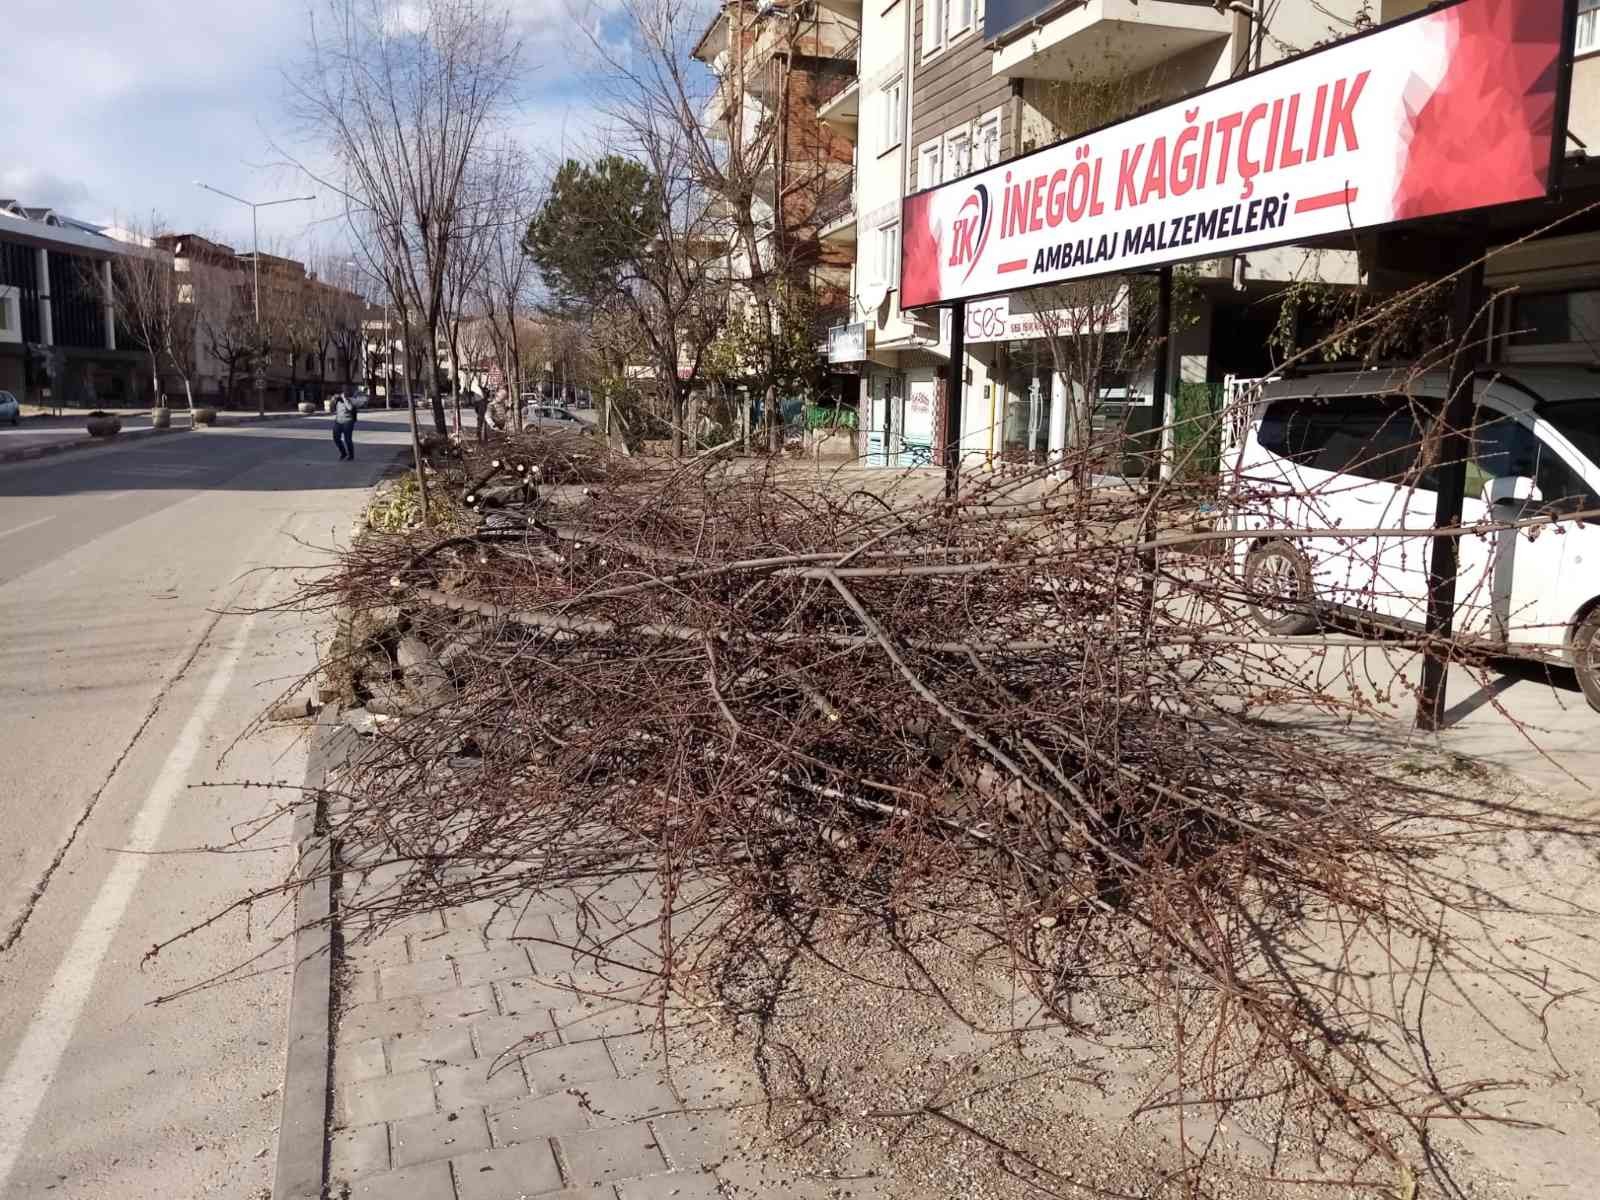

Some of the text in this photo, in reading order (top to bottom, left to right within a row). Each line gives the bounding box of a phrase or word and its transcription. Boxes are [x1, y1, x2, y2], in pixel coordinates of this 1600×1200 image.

[1000, 69, 1371, 239] İNEGÖL KAĞITÇILIK
[1033, 231, 1118, 275] AMBALAJ
